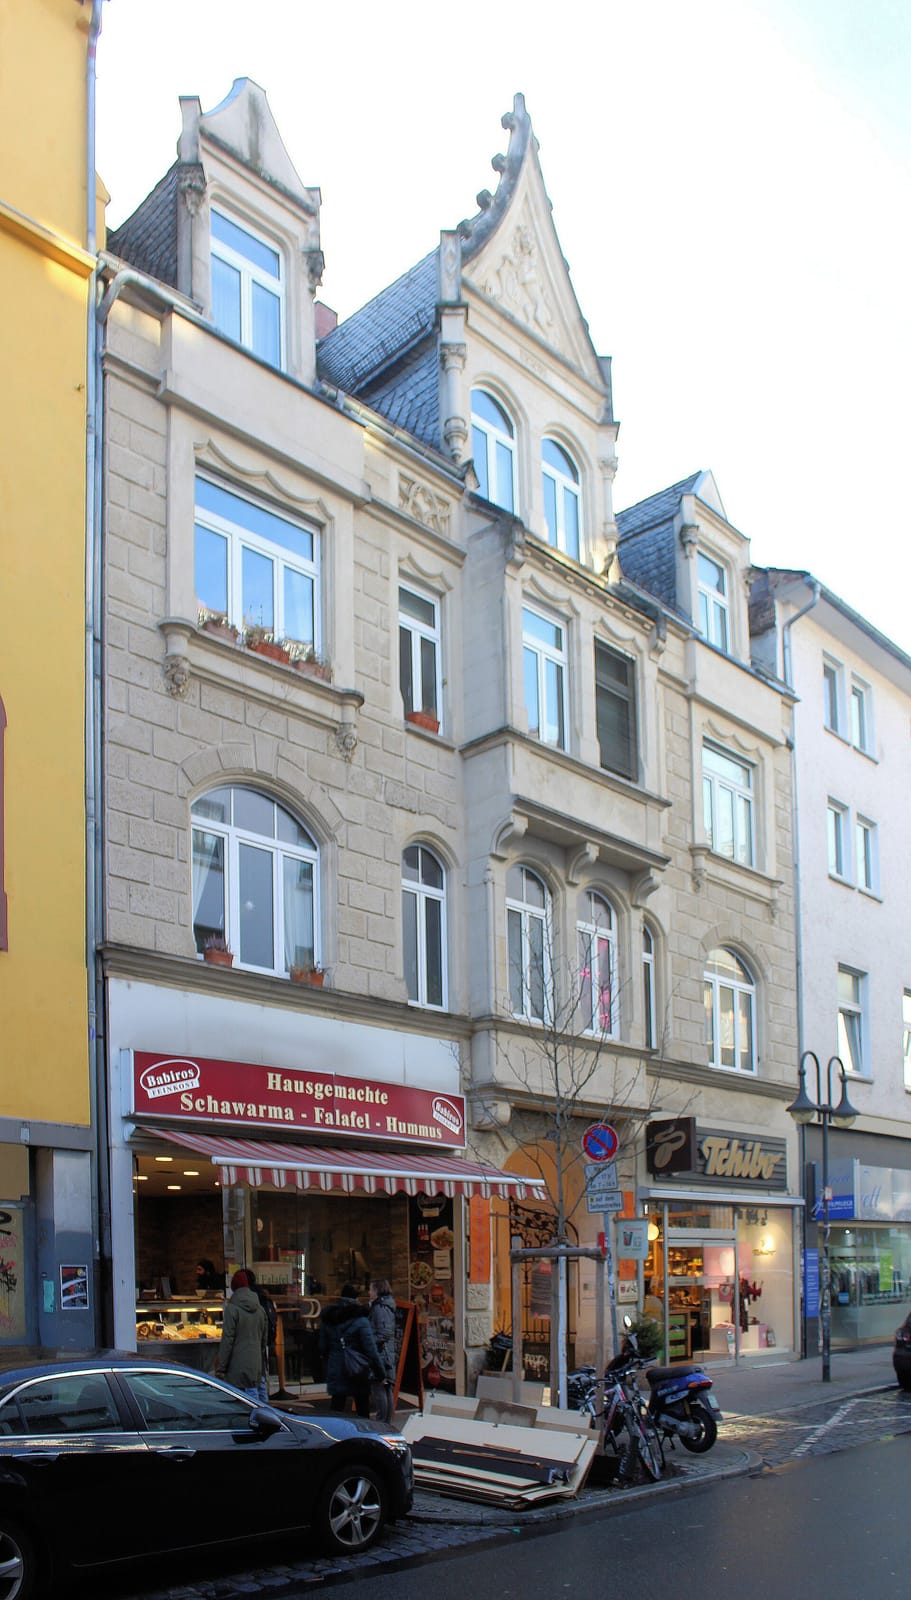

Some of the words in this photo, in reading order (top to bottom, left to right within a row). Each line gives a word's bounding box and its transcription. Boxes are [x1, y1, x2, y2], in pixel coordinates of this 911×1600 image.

[147, 1069, 195, 1087] Babiros
[267, 1072, 388, 1105] Hausgemachte
[180, 1093, 295, 1121] Schawarma
[314, 1107, 370, 1129] Falafel
[386, 1116, 443, 1139] Hummus
[701, 1136, 784, 1179] Tchibo
